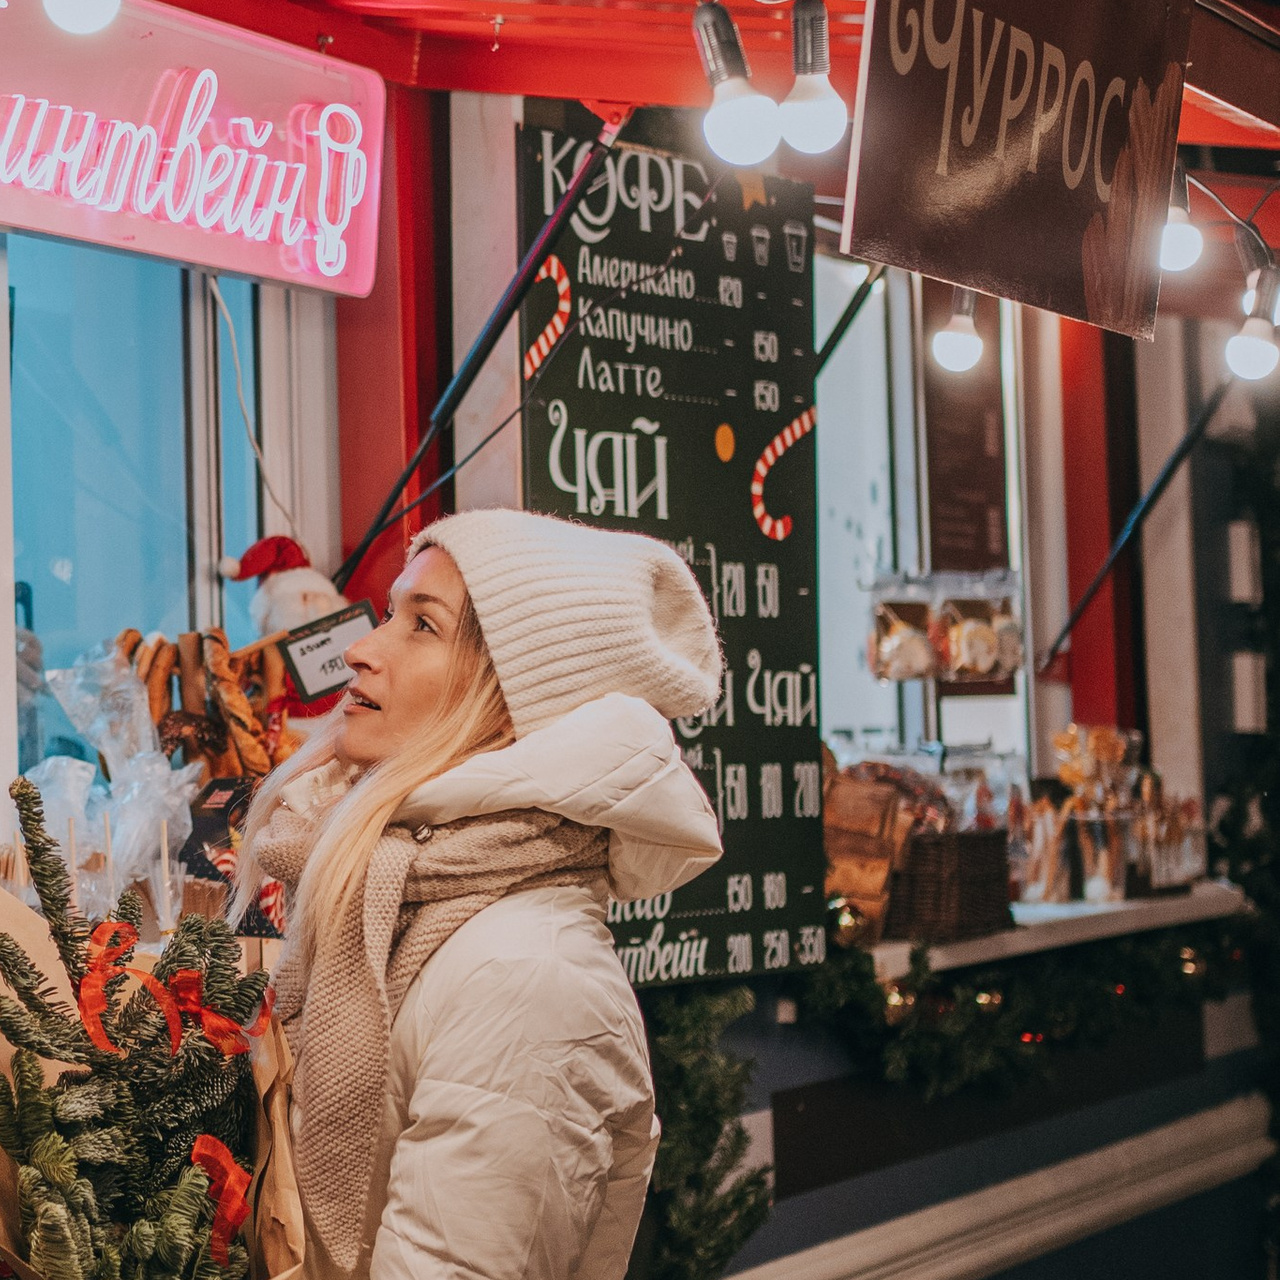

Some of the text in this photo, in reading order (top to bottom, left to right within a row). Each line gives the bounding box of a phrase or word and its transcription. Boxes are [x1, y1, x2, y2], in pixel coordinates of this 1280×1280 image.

[577, 244, 695, 299] Американо
[578, 295, 693, 353] Капучино
[577, 346, 664, 398] Латте
